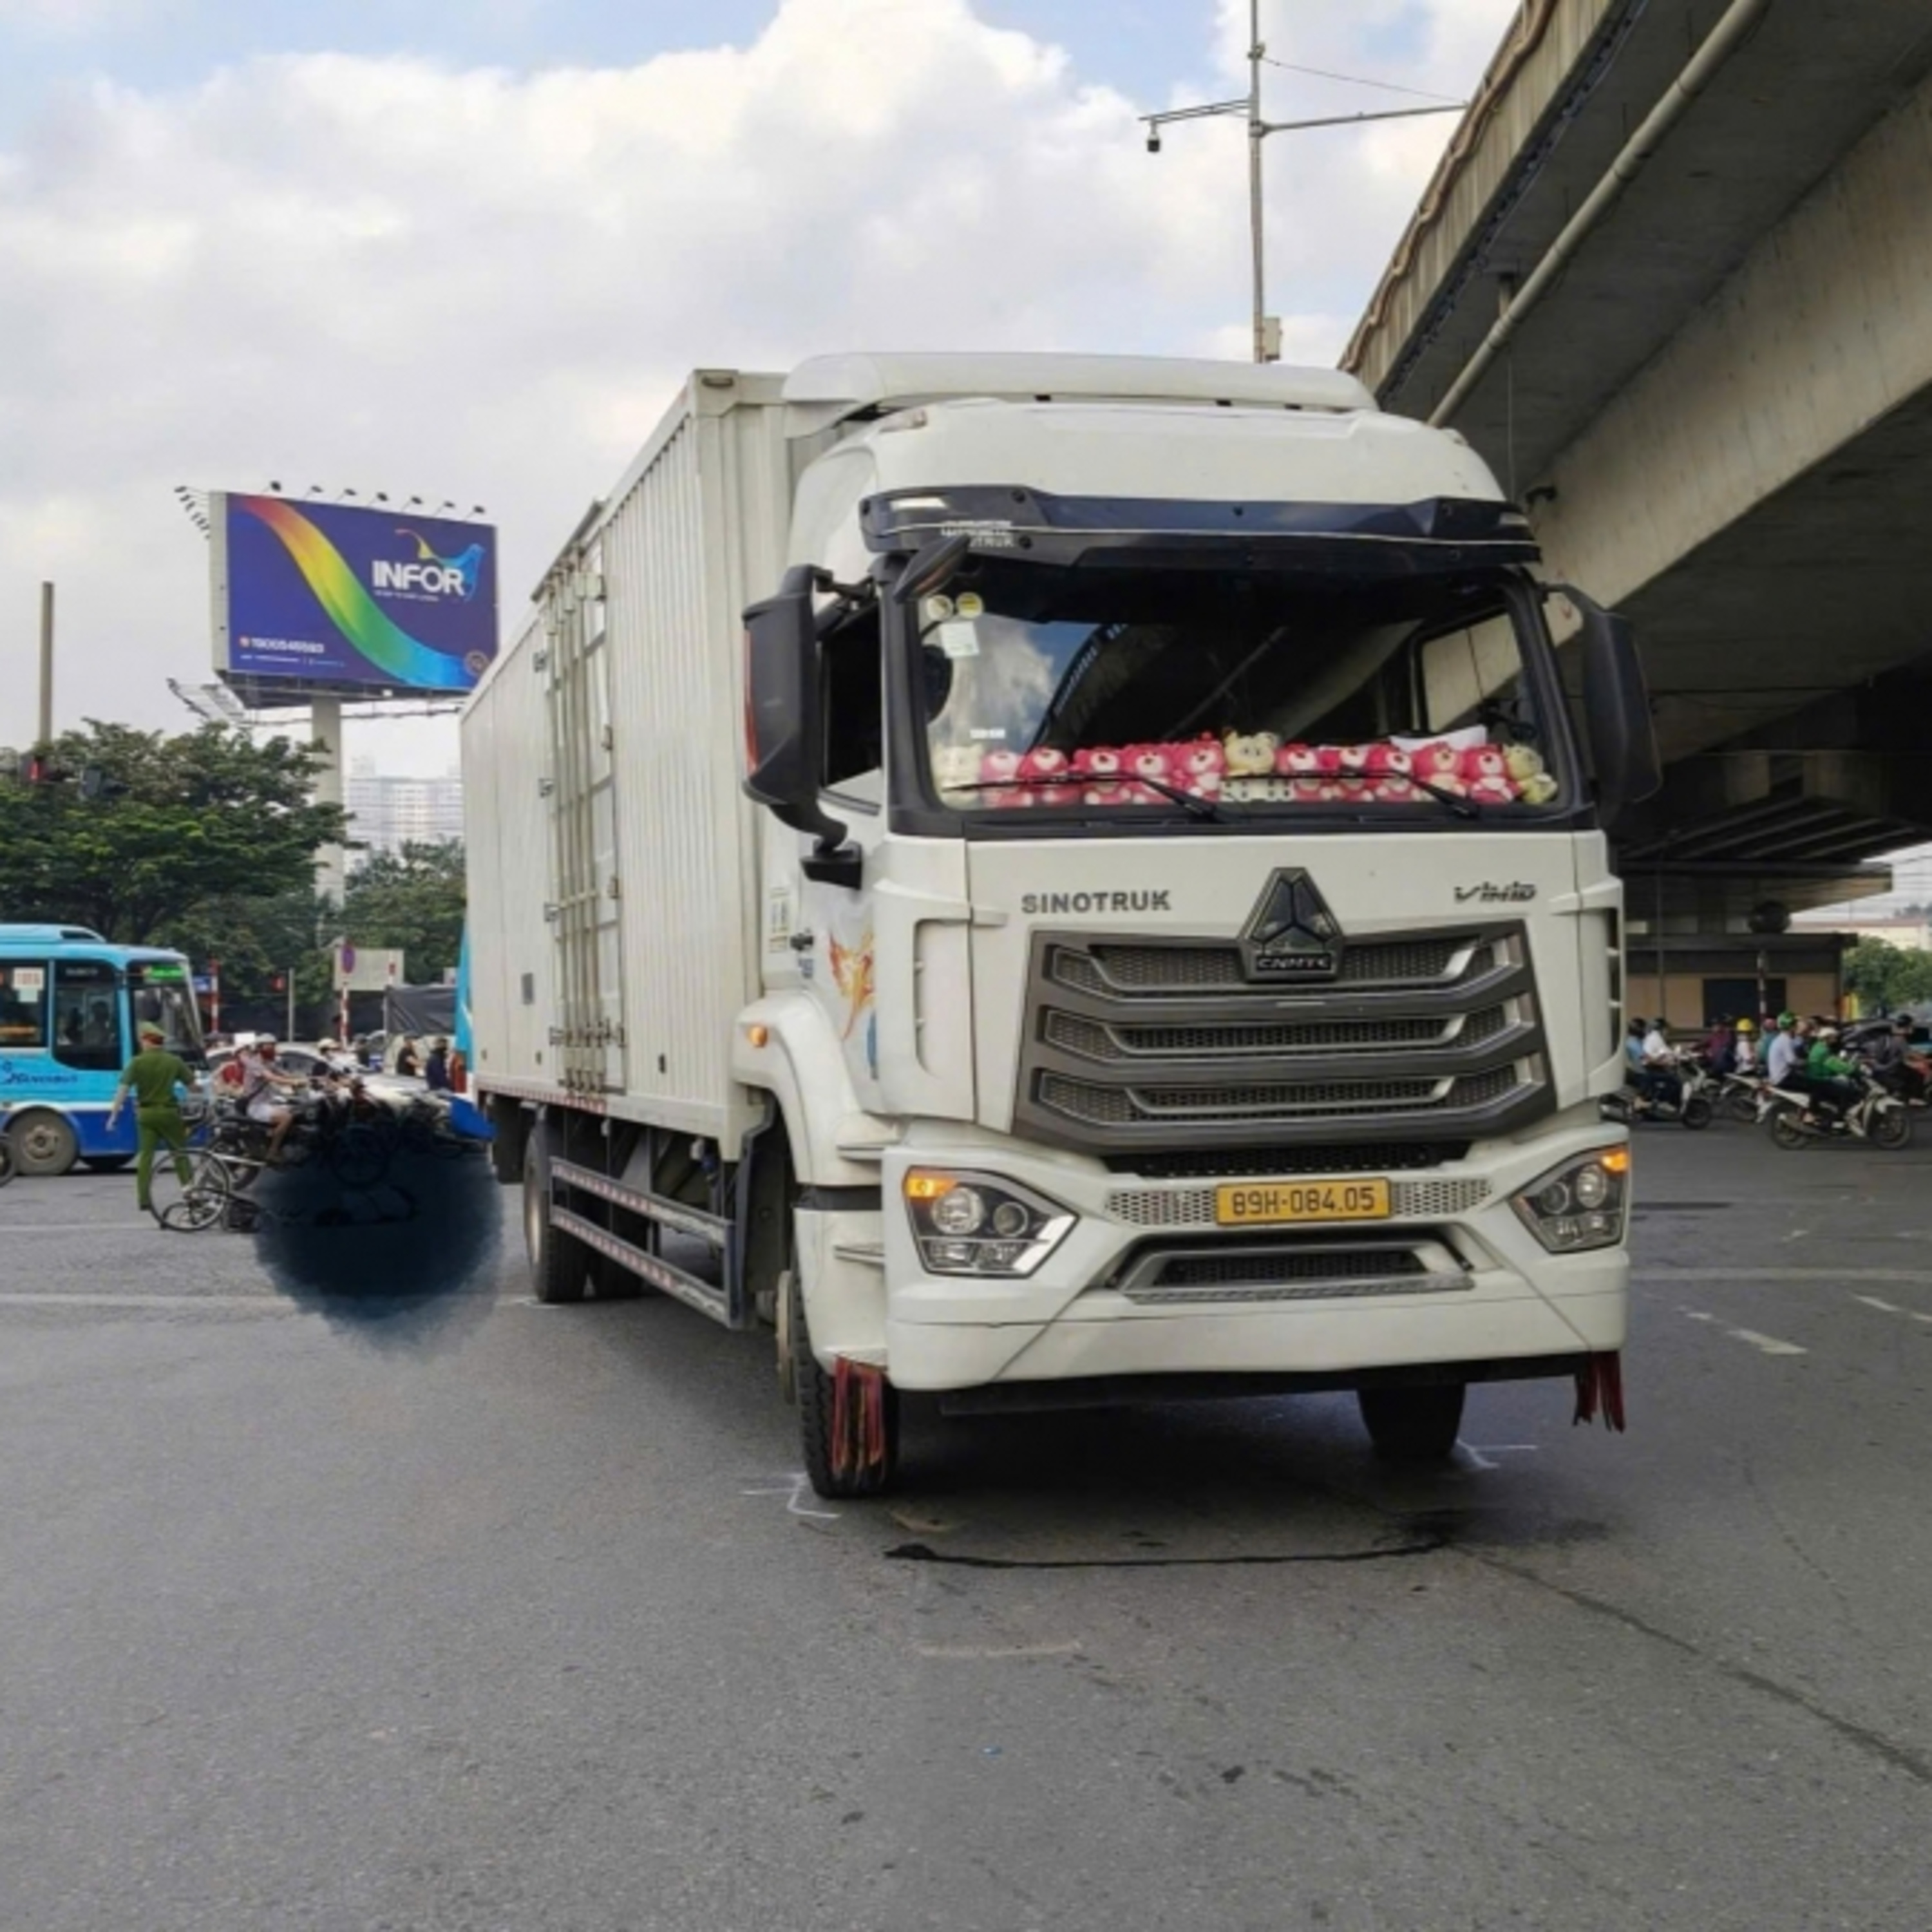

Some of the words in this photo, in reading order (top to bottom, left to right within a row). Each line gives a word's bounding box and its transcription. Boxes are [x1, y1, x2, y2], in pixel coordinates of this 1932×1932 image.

[372, 560, 464, 596] INFOR
[1021, 888, 1171, 914] SINOTRUK
[1231, 1187, 1375, 1217] 89H-084.05
